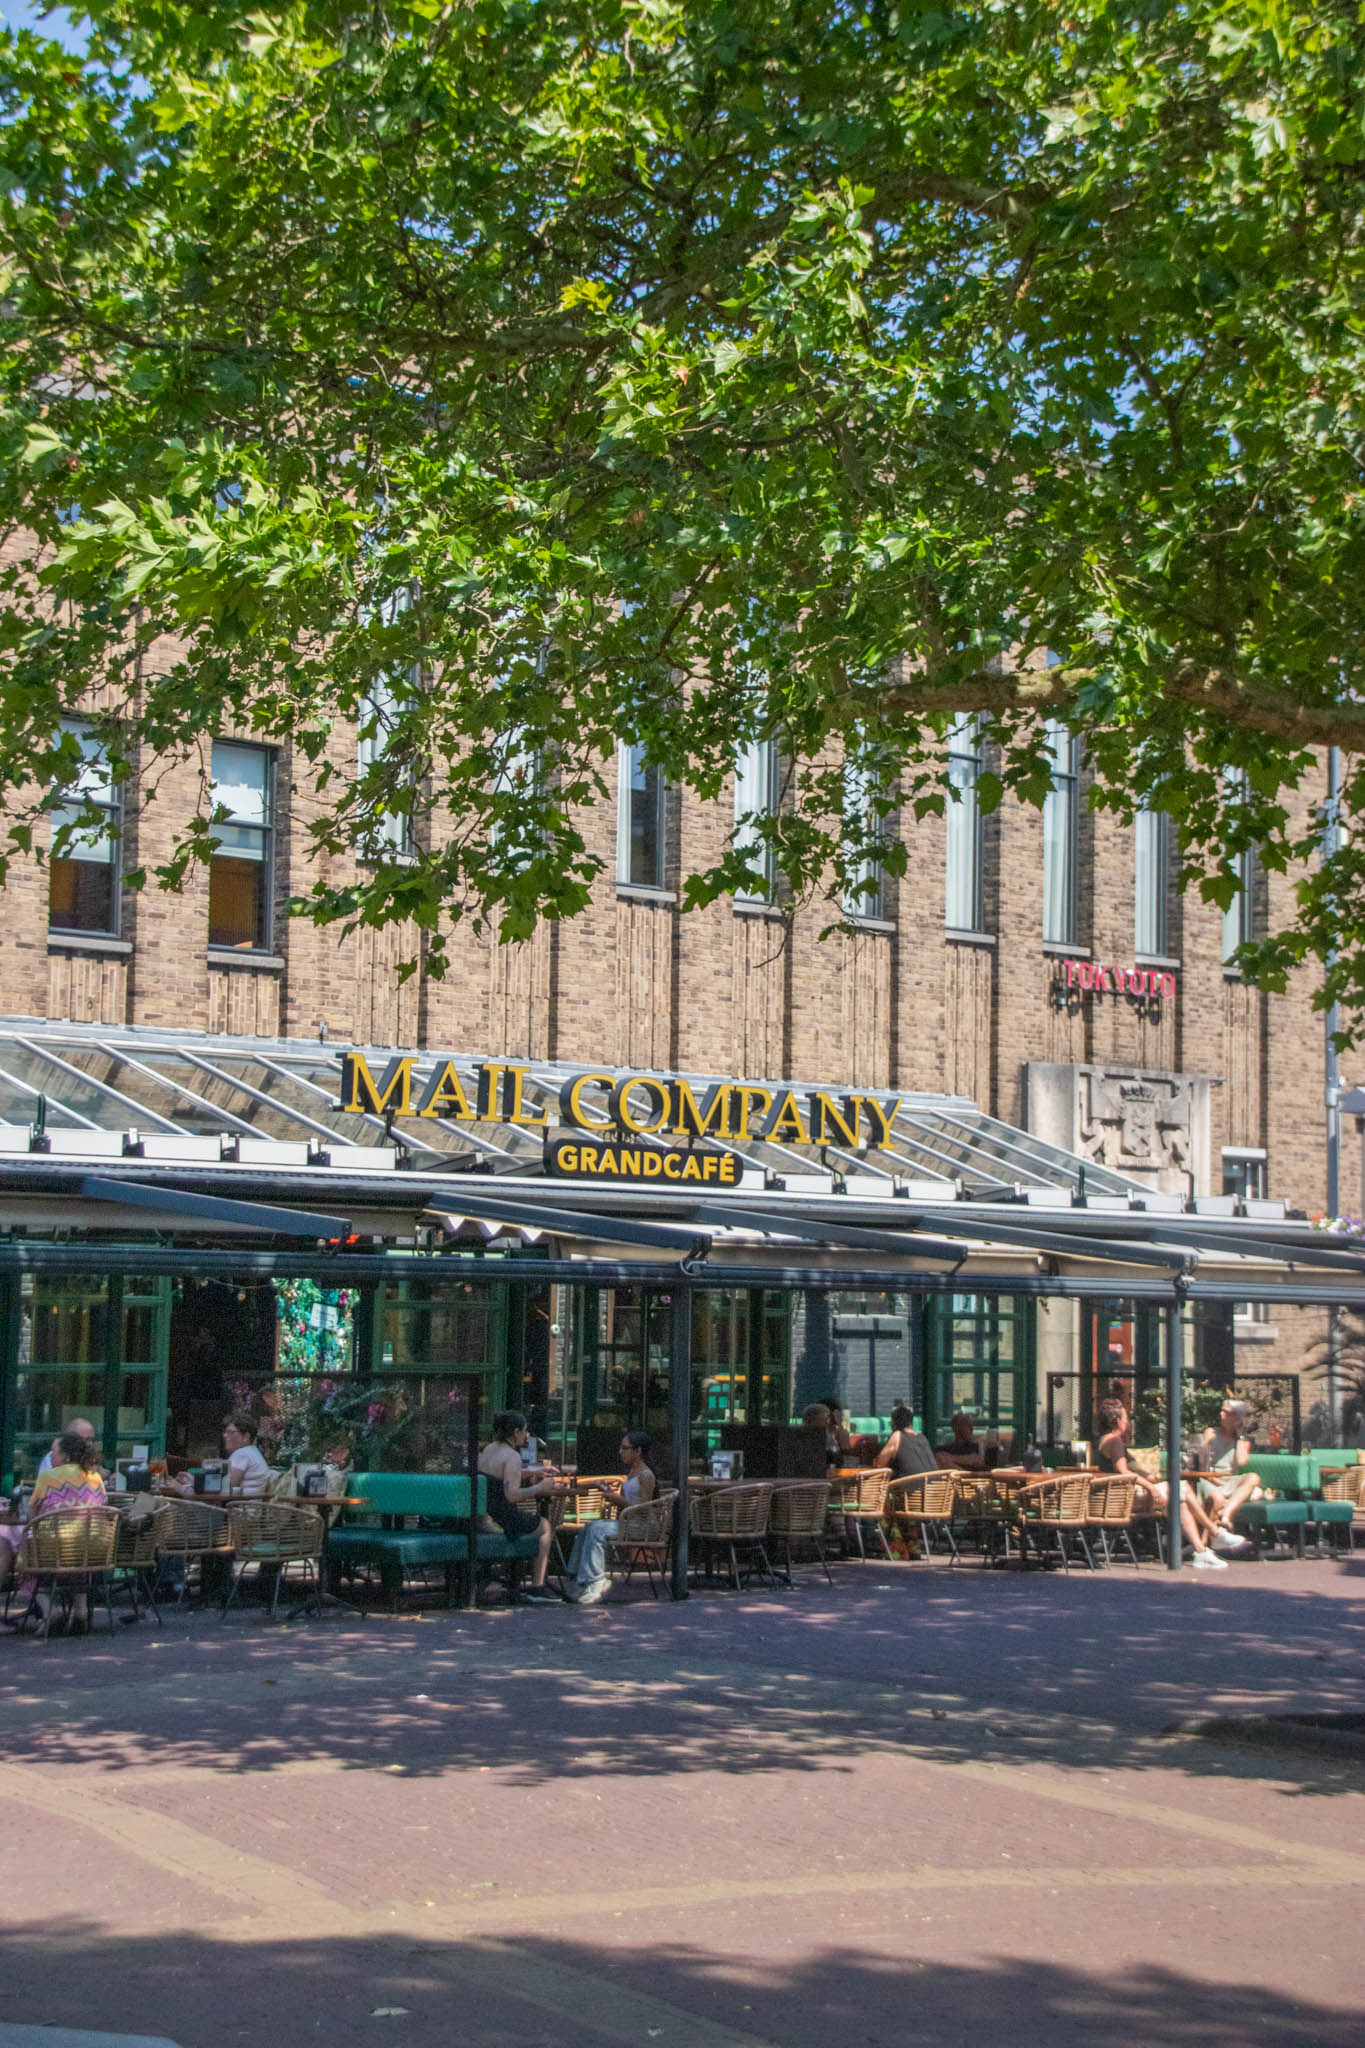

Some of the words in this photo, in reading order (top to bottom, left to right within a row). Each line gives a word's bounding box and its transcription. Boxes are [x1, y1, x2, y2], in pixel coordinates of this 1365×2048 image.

[1064, 960, 1176, 998] TOKYOTO
[341, 1052, 548, 1125] MAIL
[562, 1073, 903, 1150] COMPANY
[556, 1145, 735, 1183] GRANDCAFÉ
